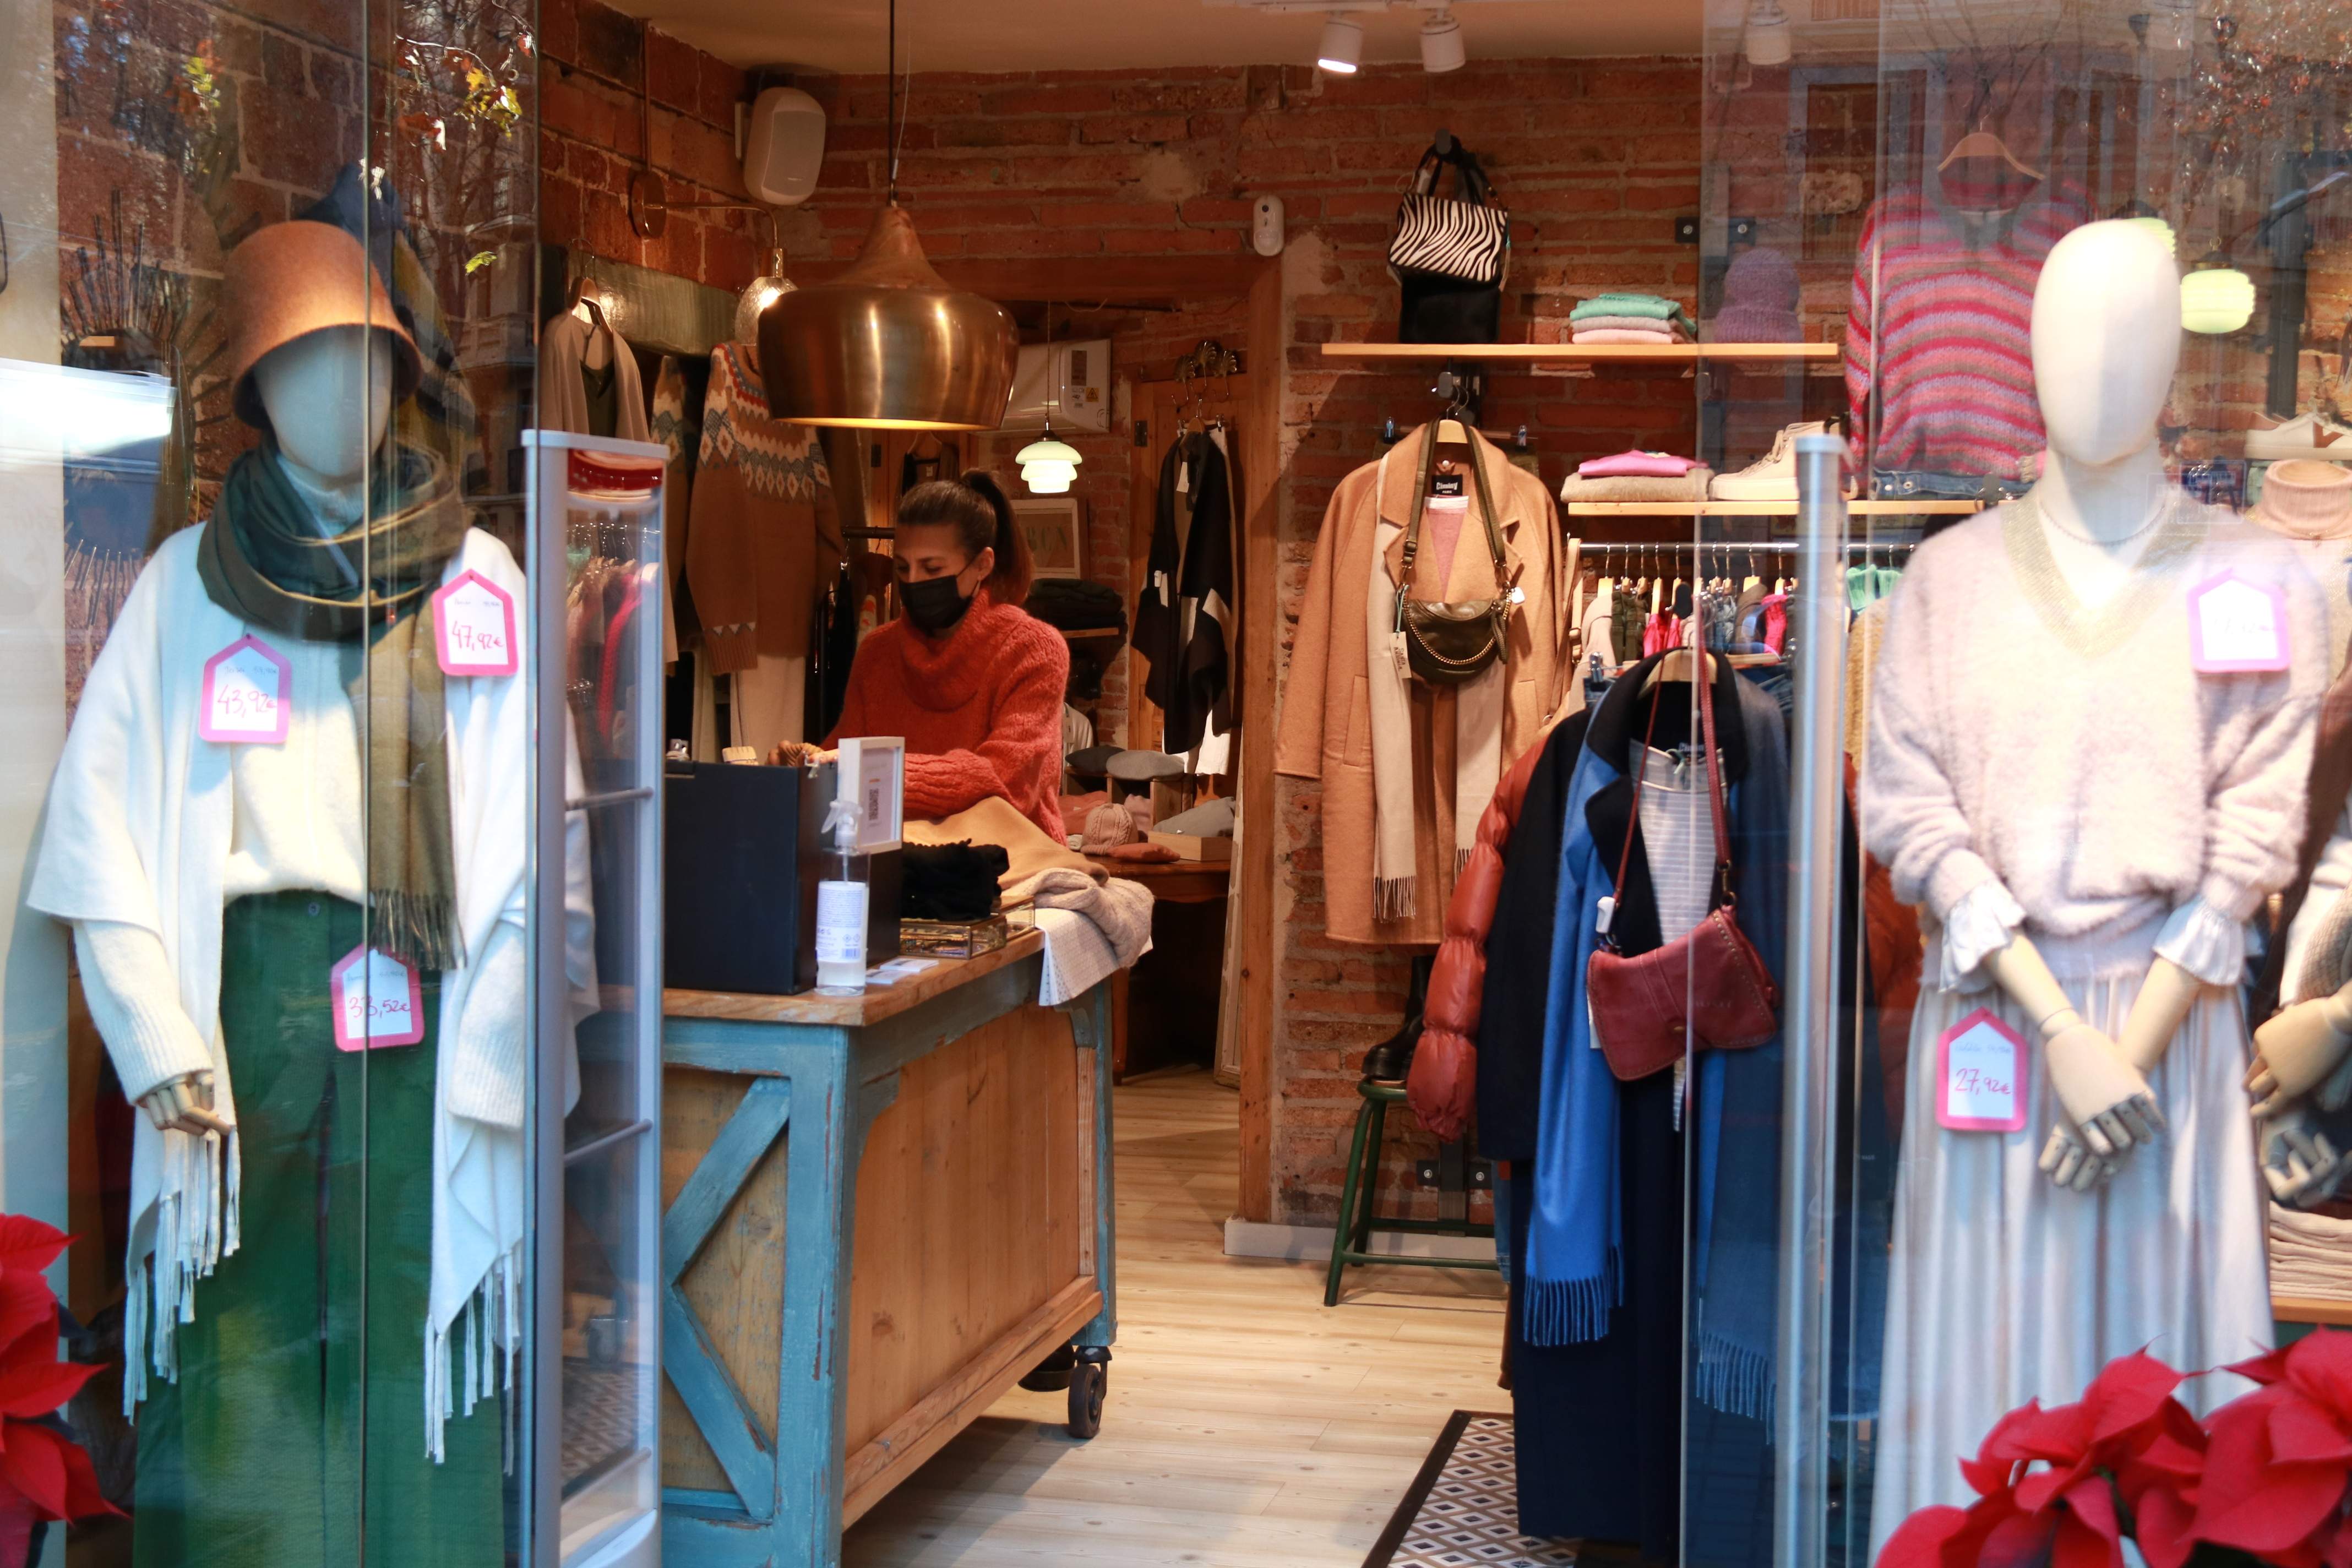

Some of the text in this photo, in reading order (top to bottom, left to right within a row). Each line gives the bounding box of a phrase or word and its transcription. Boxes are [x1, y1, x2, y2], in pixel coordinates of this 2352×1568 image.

[451, 620, 504, 651] 47,92€
[217, 683, 277, 718] 43,92€
[349, 995, 411, 1019] 33,52€
[1955, 1068, 2011, 1096] 27,92€
